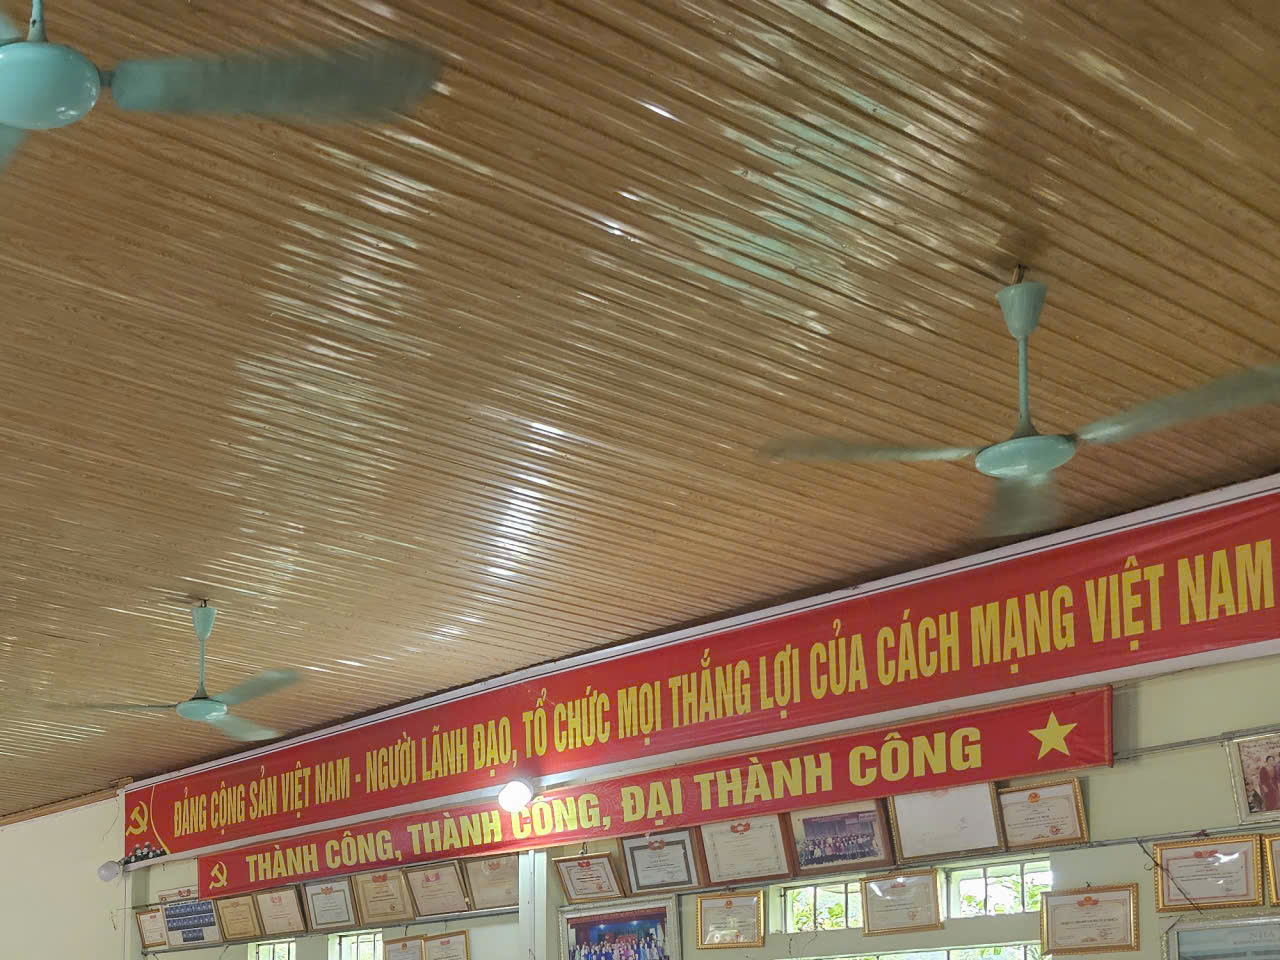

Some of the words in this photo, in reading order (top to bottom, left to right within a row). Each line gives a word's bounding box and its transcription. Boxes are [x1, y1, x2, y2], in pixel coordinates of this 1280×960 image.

[174, 786, 207, 838] ĐẢNG
[210, 780, 245, 835] CỘNG
[249, 765, 278, 820] SẢN
[281, 761, 311, 818] VIỆT
[315, 756, 351, 805] NAM
[365, 731, 416, 793] NGƯỜI
[421, 724, 468, 781] LÃNH
[473, 716, 518, 777] ĐẠO,
[522, 687, 548, 758] TỔ
[553, 685, 610, 753] CHỨC
[617, 680, 662, 746] MỌI
[668, 648, 751, 729] THẮNG
[759, 643, 801, 719] LỢI
[809, 618, 868, 699] CỦA
[876, 608, 960, 686] CÁCH
[970, 584, 1075, 674] MẠNG
[1084, 555, 1165, 651] VIỆT
[1177, 538, 1275, 626] NAM
[245, 843, 319, 883] THÀNH
[324, 829, 402, 869] CÔNG,
[407, 810, 502, 854] THÀNH
[511, 793, 611, 840] CÔNG,
[620, 778, 683, 825] ĐẠI
[693, 751, 833, 811] THÀNH
[848, 726, 982, 787] CÔNG
